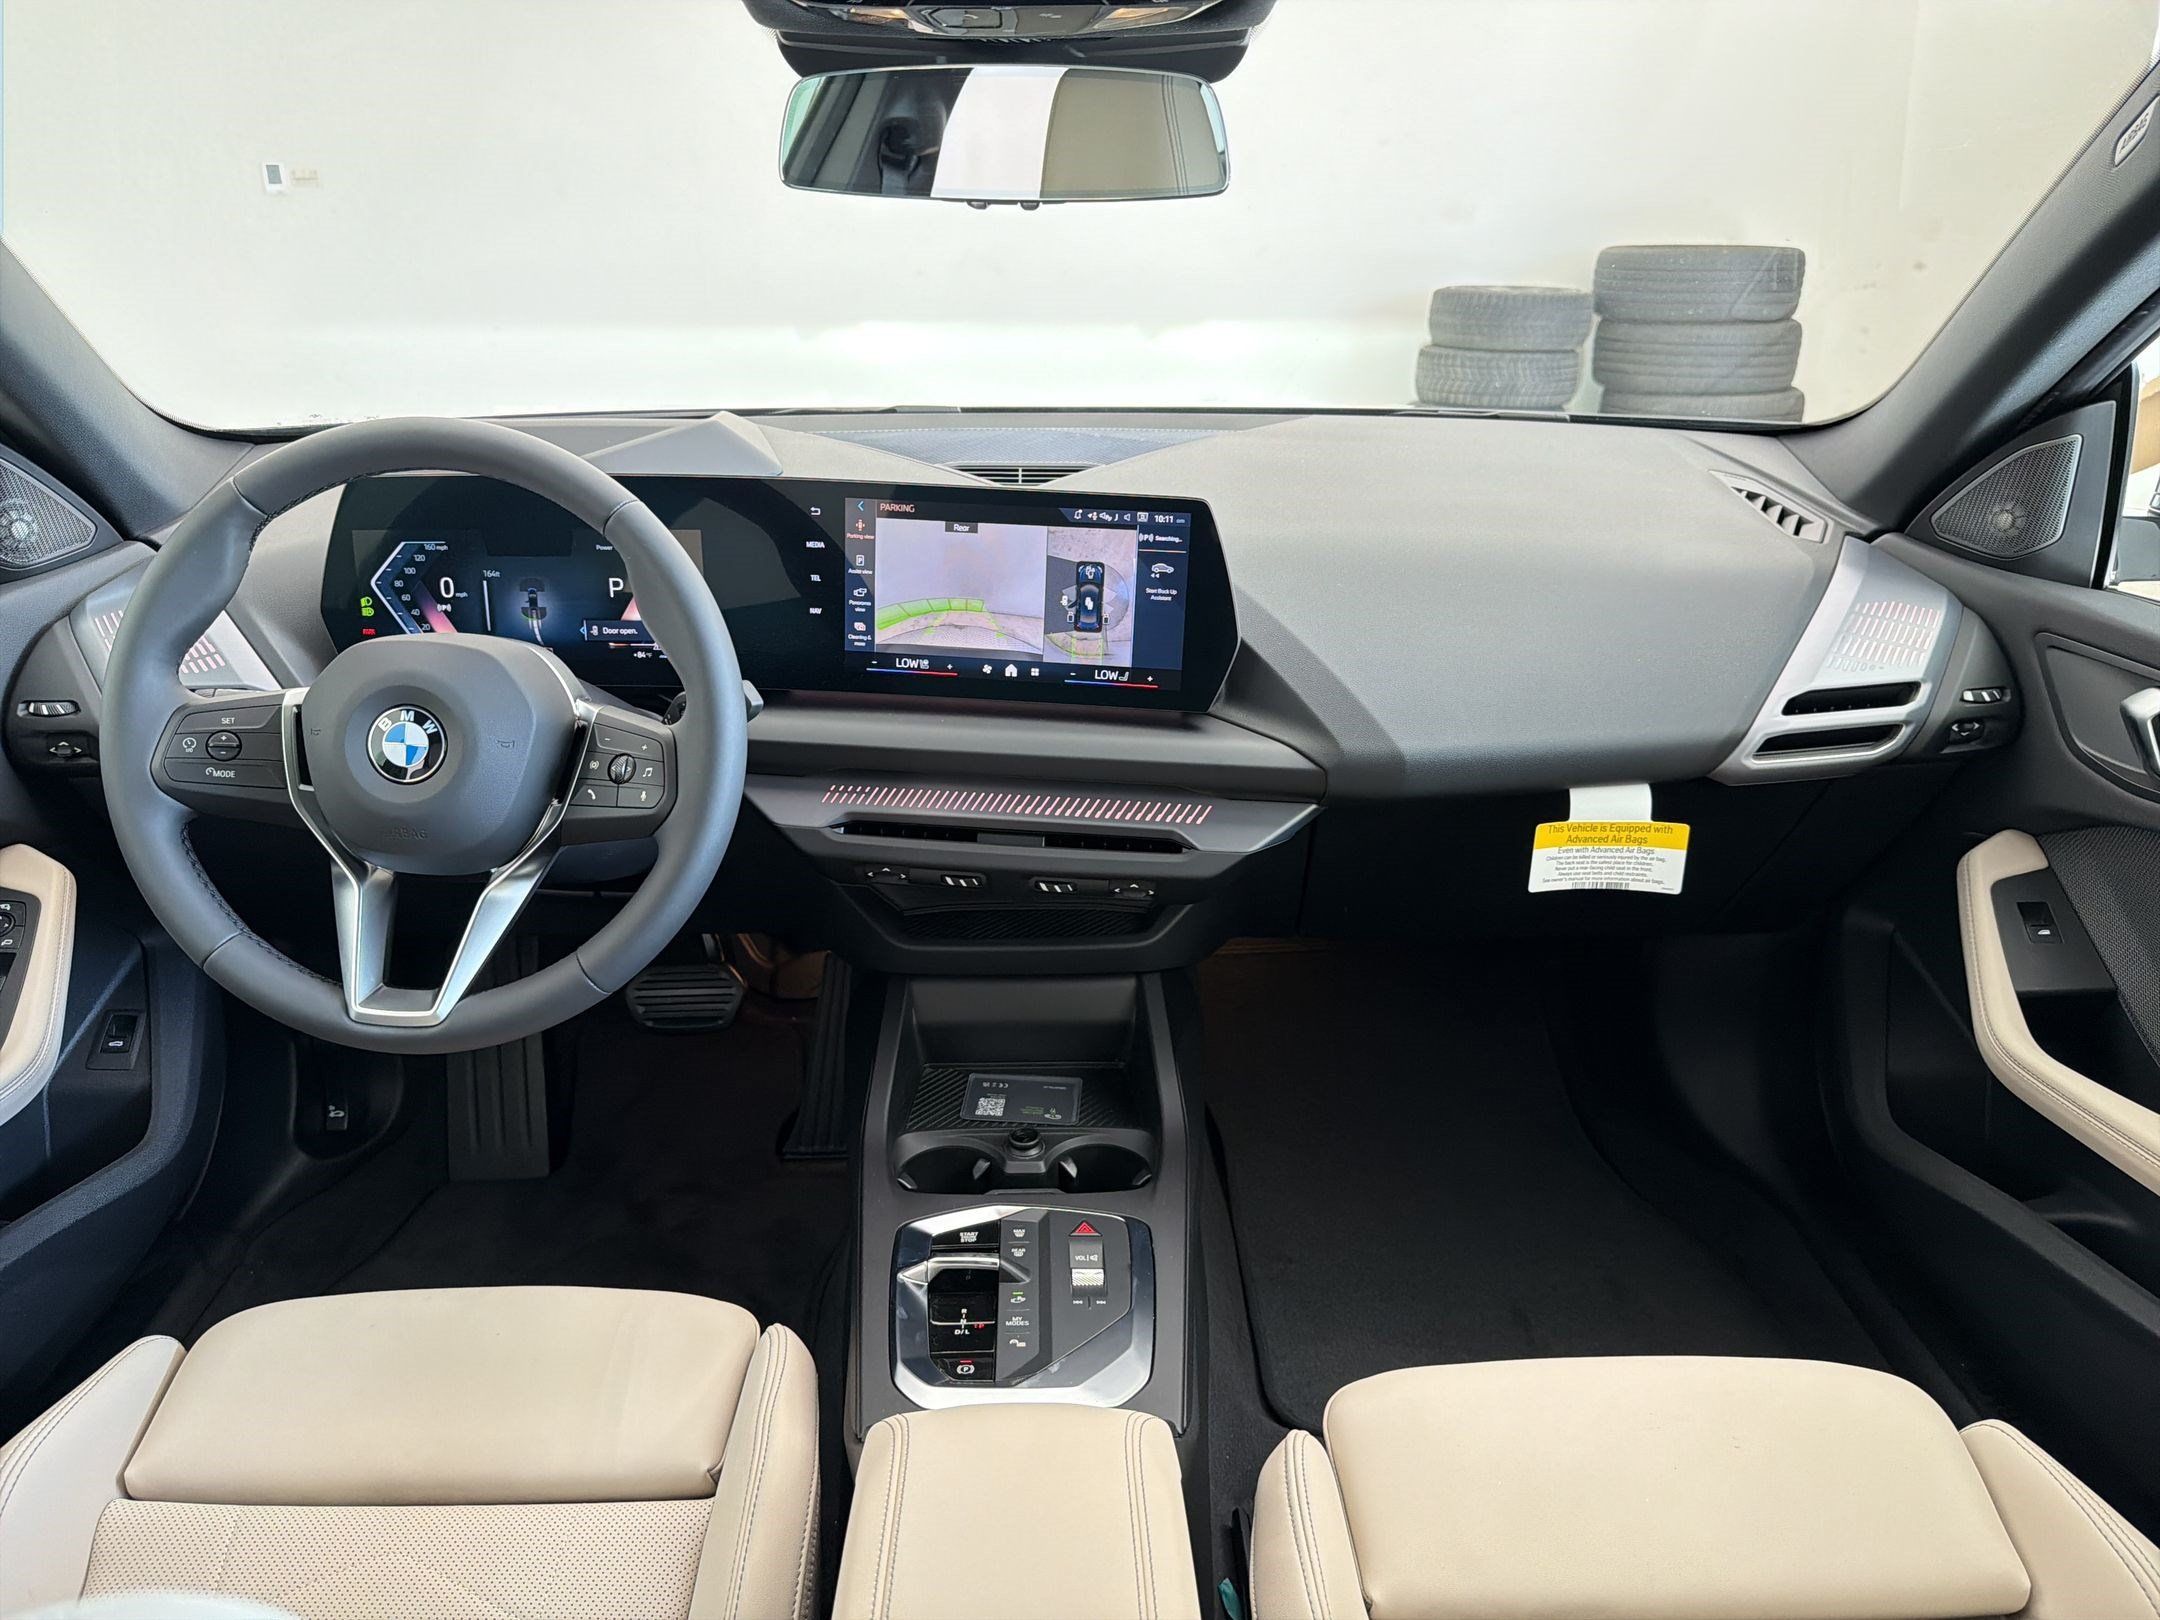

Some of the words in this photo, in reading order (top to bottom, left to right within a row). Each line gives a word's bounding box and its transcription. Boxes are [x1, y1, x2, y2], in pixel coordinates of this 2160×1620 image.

[880, 503, 915, 513] PARKING
[1154, 515, 1174, 523] 10:11
[953, 524, 970, 532] Rear
[440, 577, 455, 598] 0
[609, 578, 624, 598] P
[620, 628, 638, 636] open.
[896, 658, 919, 668] LOW
[1095, 670, 1119, 680] LOW
[378, 710, 438, 735] BMW
[213, 770, 236, 778] MODE
[1549, 824, 1565, 834] This
[1567, 824, 1598, 832] Vehicle
[1600, 824, 1607, 832] is
[1609, 824, 1652, 834] Equipped
[1654, 825, 1673, 834] with
[1566, 834, 1610, 844] Advanced
[1611, 835, 1624, 843] Air
[1625, 835, 1649, 846] Bags
[1636, 847, 1655, 855] Bags
